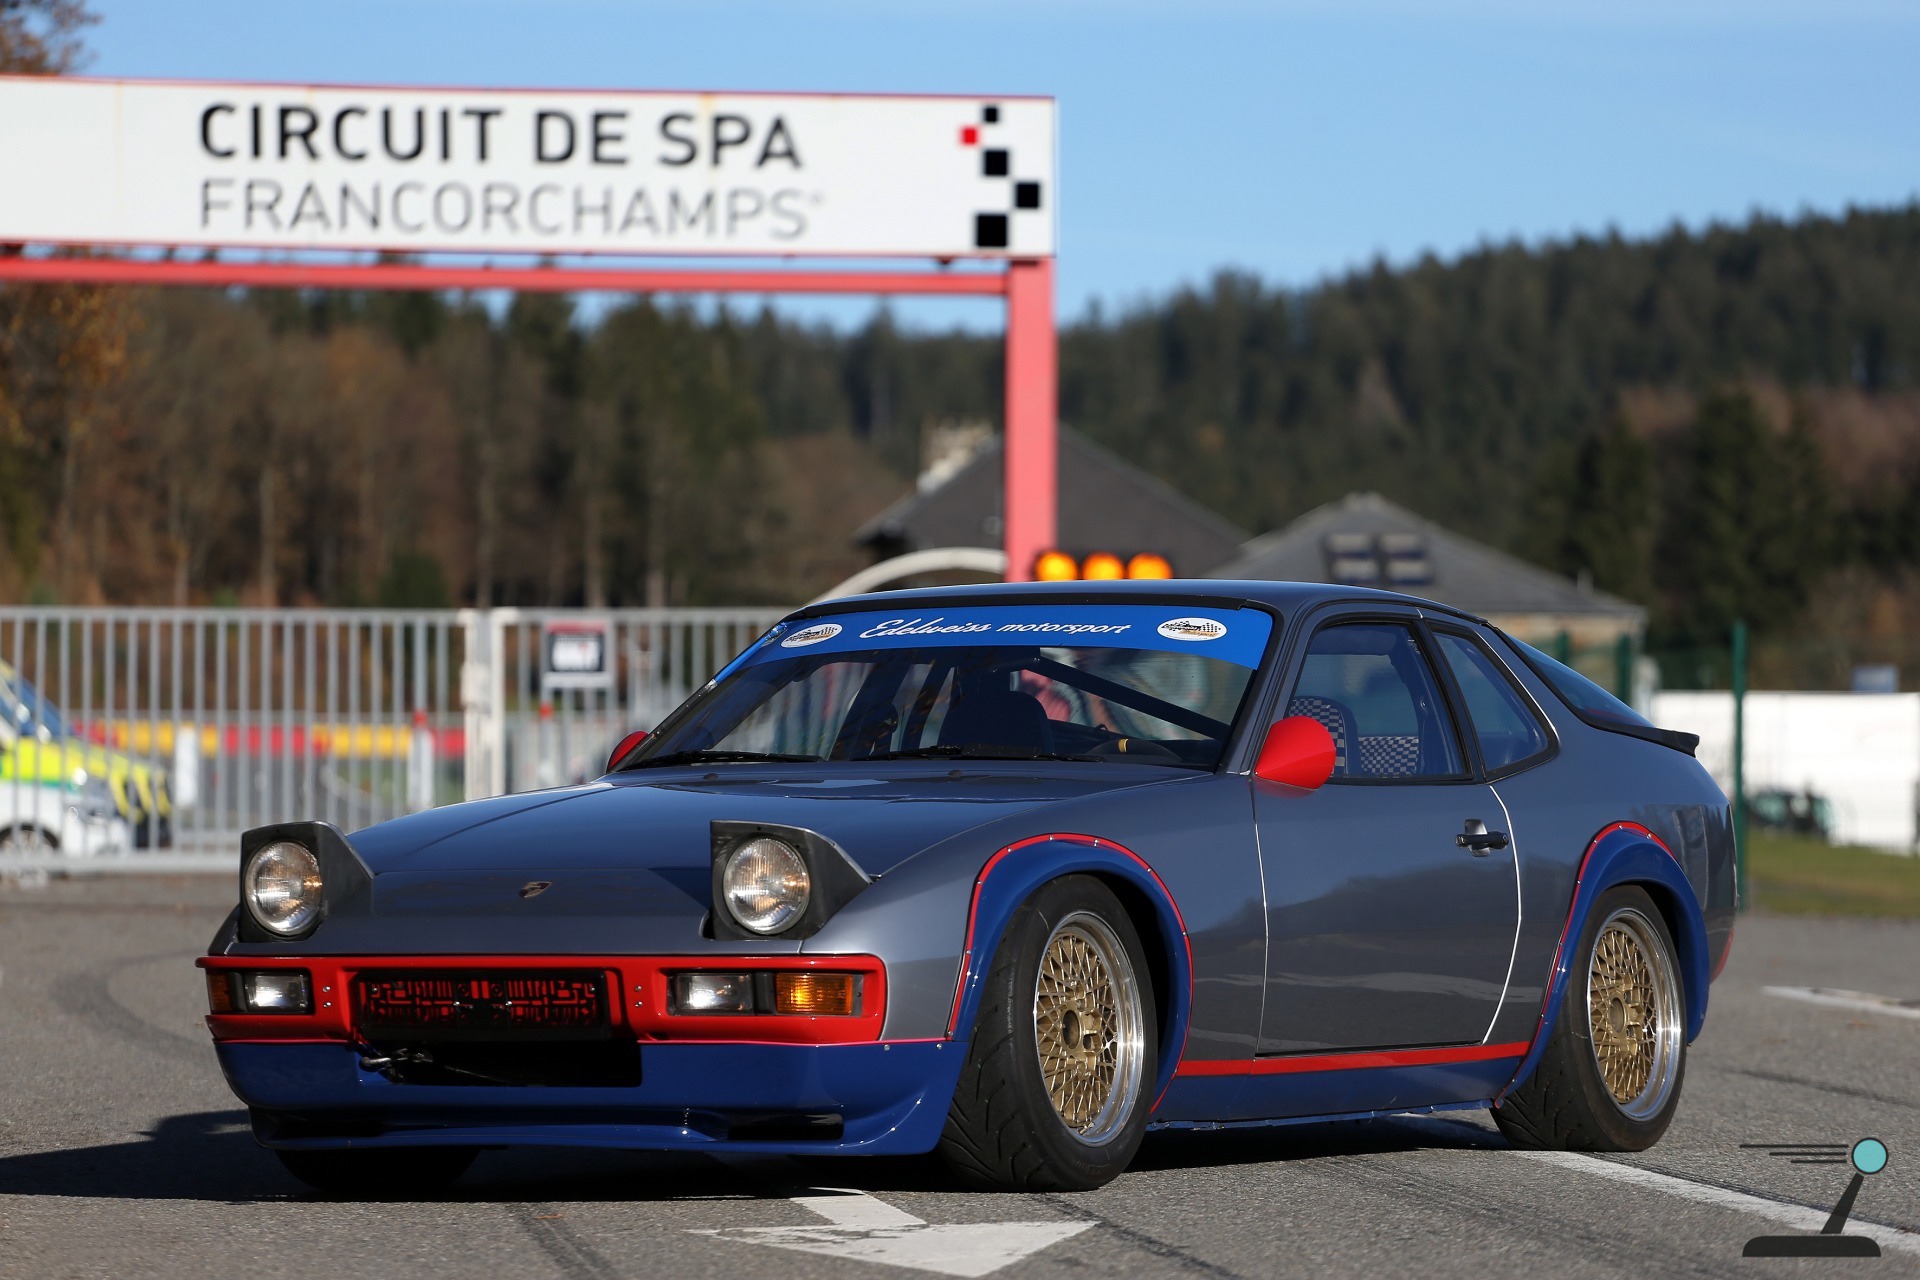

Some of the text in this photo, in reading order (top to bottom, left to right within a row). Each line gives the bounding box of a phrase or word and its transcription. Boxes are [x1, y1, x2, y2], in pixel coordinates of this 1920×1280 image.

[200, 102, 803, 169] CIRCUIT DE SPA
[199, 177, 808, 239] FRANCORCHAMPS
[859, 617, 1132, 638] Edelweiss motorsport
